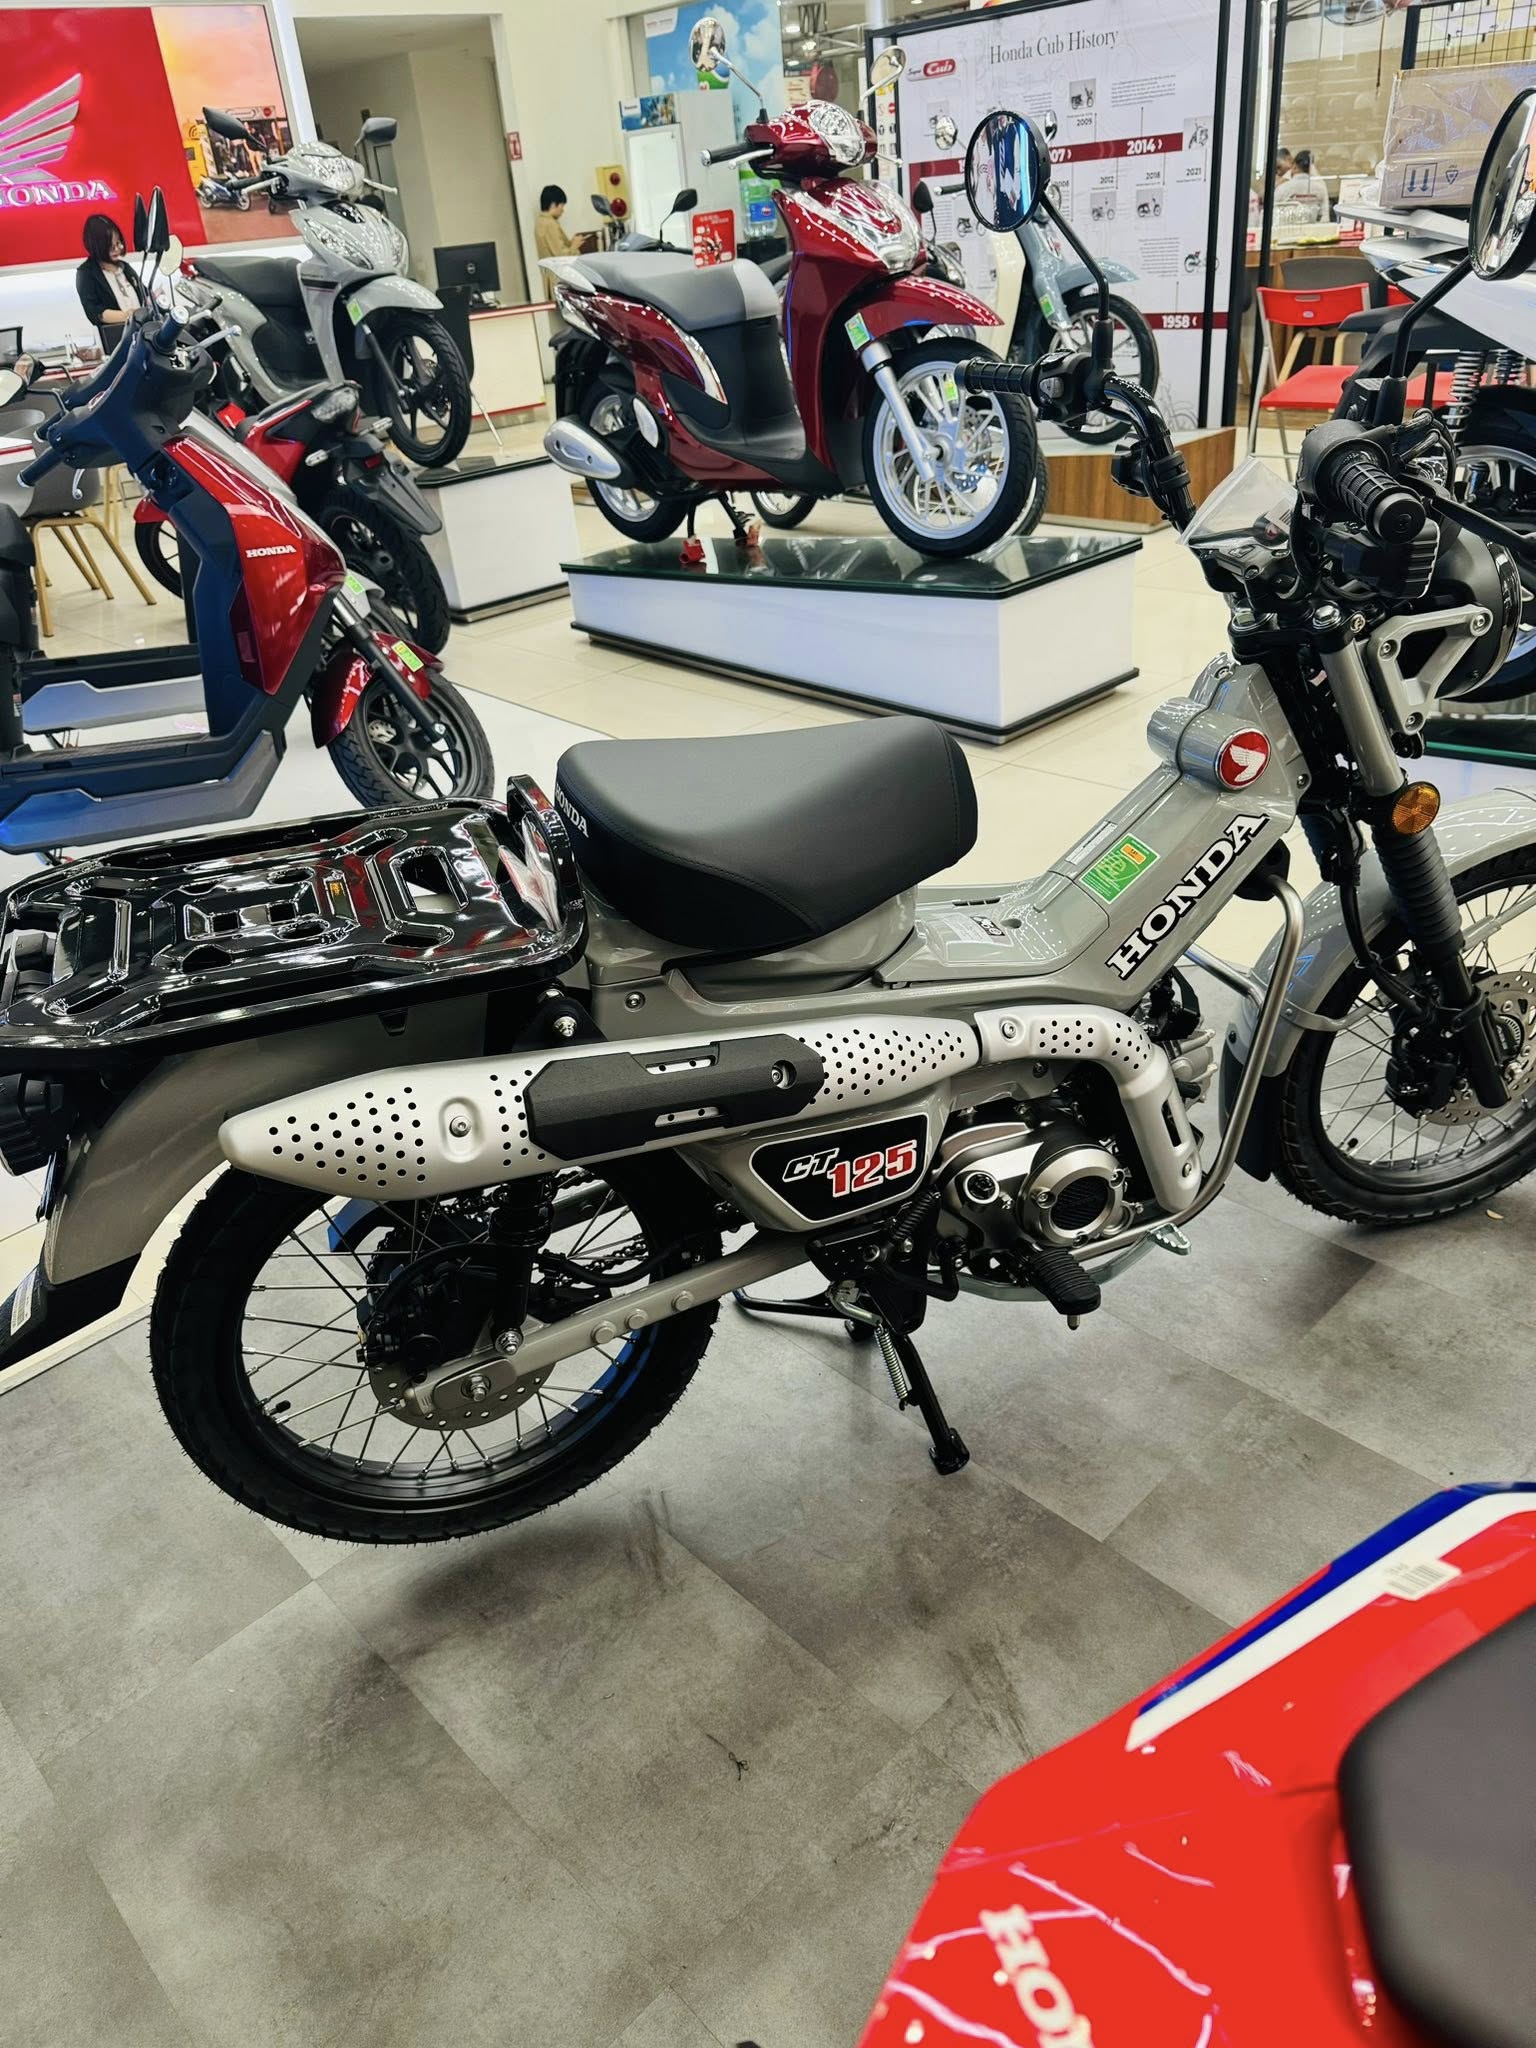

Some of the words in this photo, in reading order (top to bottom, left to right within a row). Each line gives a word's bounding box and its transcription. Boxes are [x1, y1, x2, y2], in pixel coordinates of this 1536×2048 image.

[990, 46, 1033, 64] Honda
[1036, 37, 1064, 56] Cub
[1069, 30, 1119, 51] History
[926, 60, 953, 75] Cub
[1126, 139, 1156, 156] 2014
[1161, 314, 1191, 329] 1958
[245, 544, 297, 559] HONDA
[1104, 813, 1271, 980] HONDA
[978, 1903, 1096, 2048] HO
